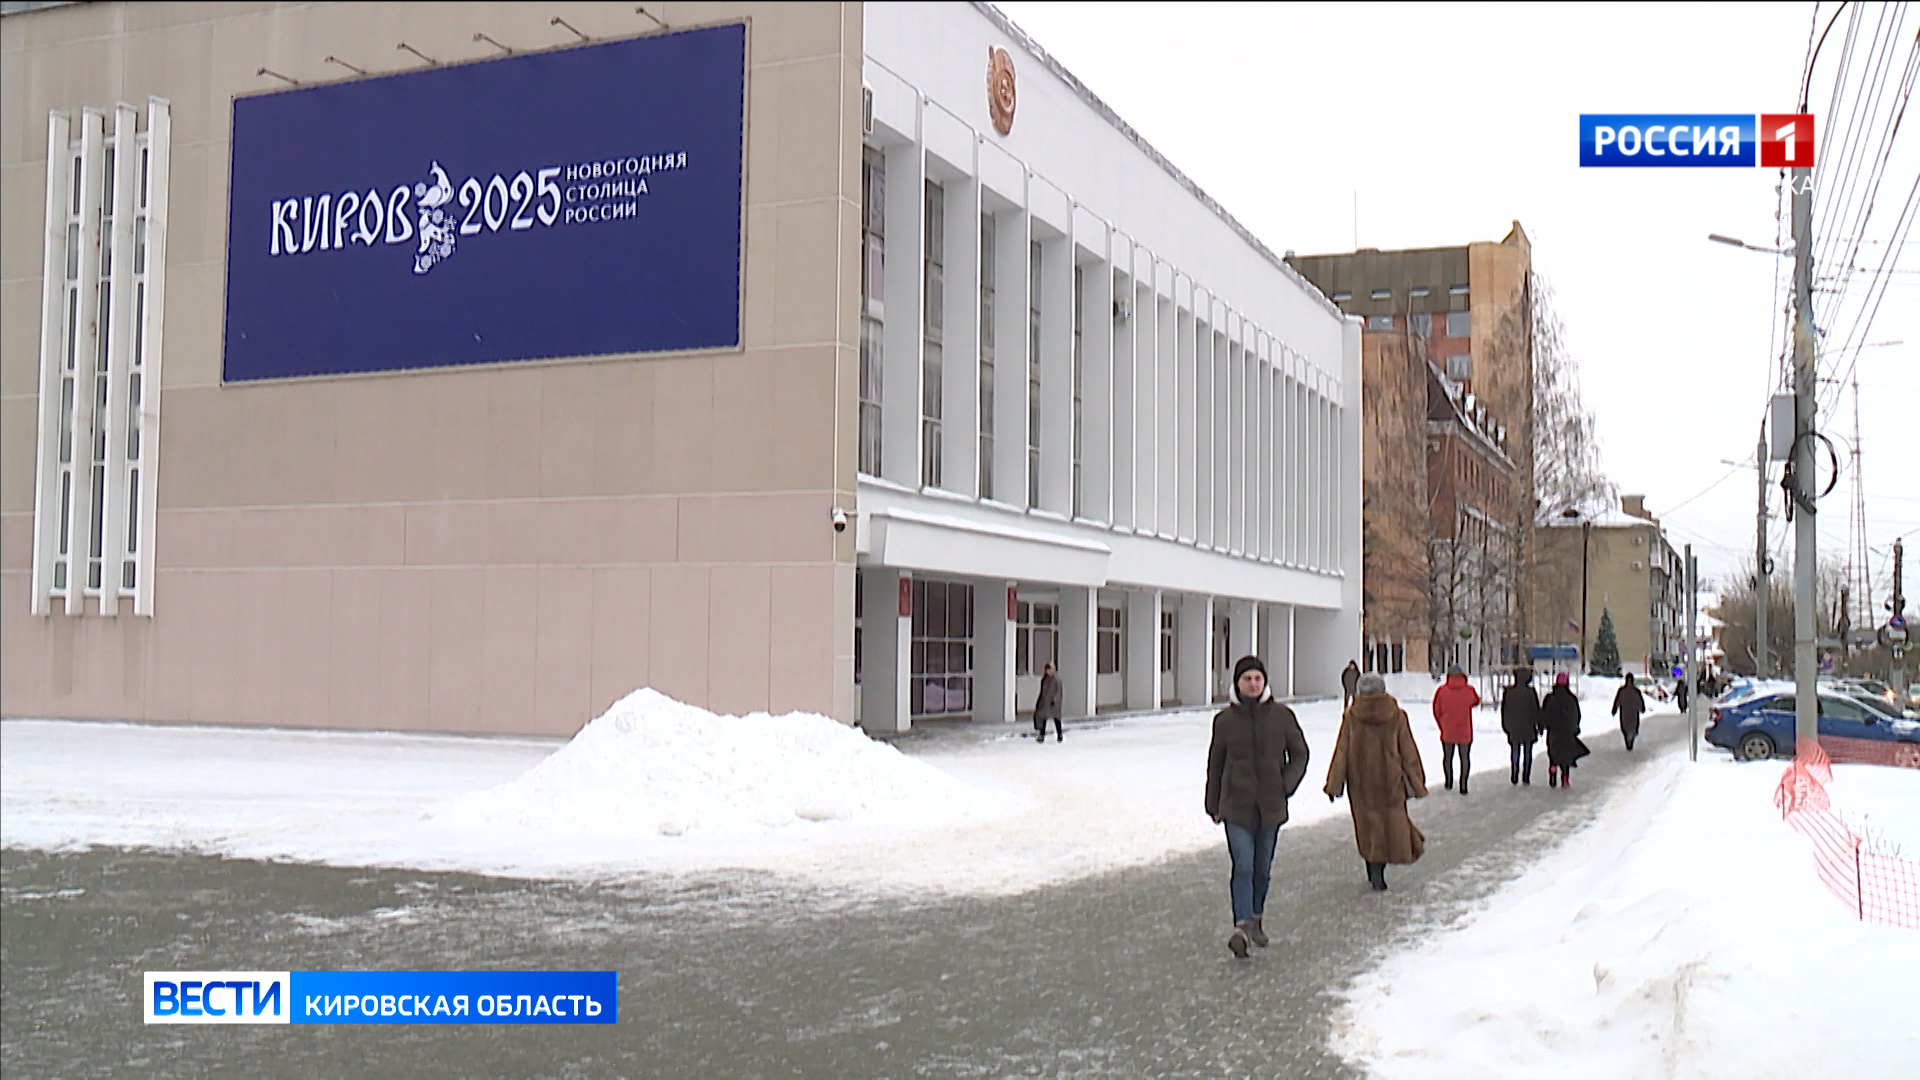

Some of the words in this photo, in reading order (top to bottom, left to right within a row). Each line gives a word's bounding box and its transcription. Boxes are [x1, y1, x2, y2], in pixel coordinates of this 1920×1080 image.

[567, 151, 687, 180] НОВОГОДНЯЯ
[566, 179, 648, 202] СТОЛИЦА
[271, 186, 413, 255] КИРОВ
[459, 166, 561, 235] 2025
[565, 201, 636, 224] РОССИИ
